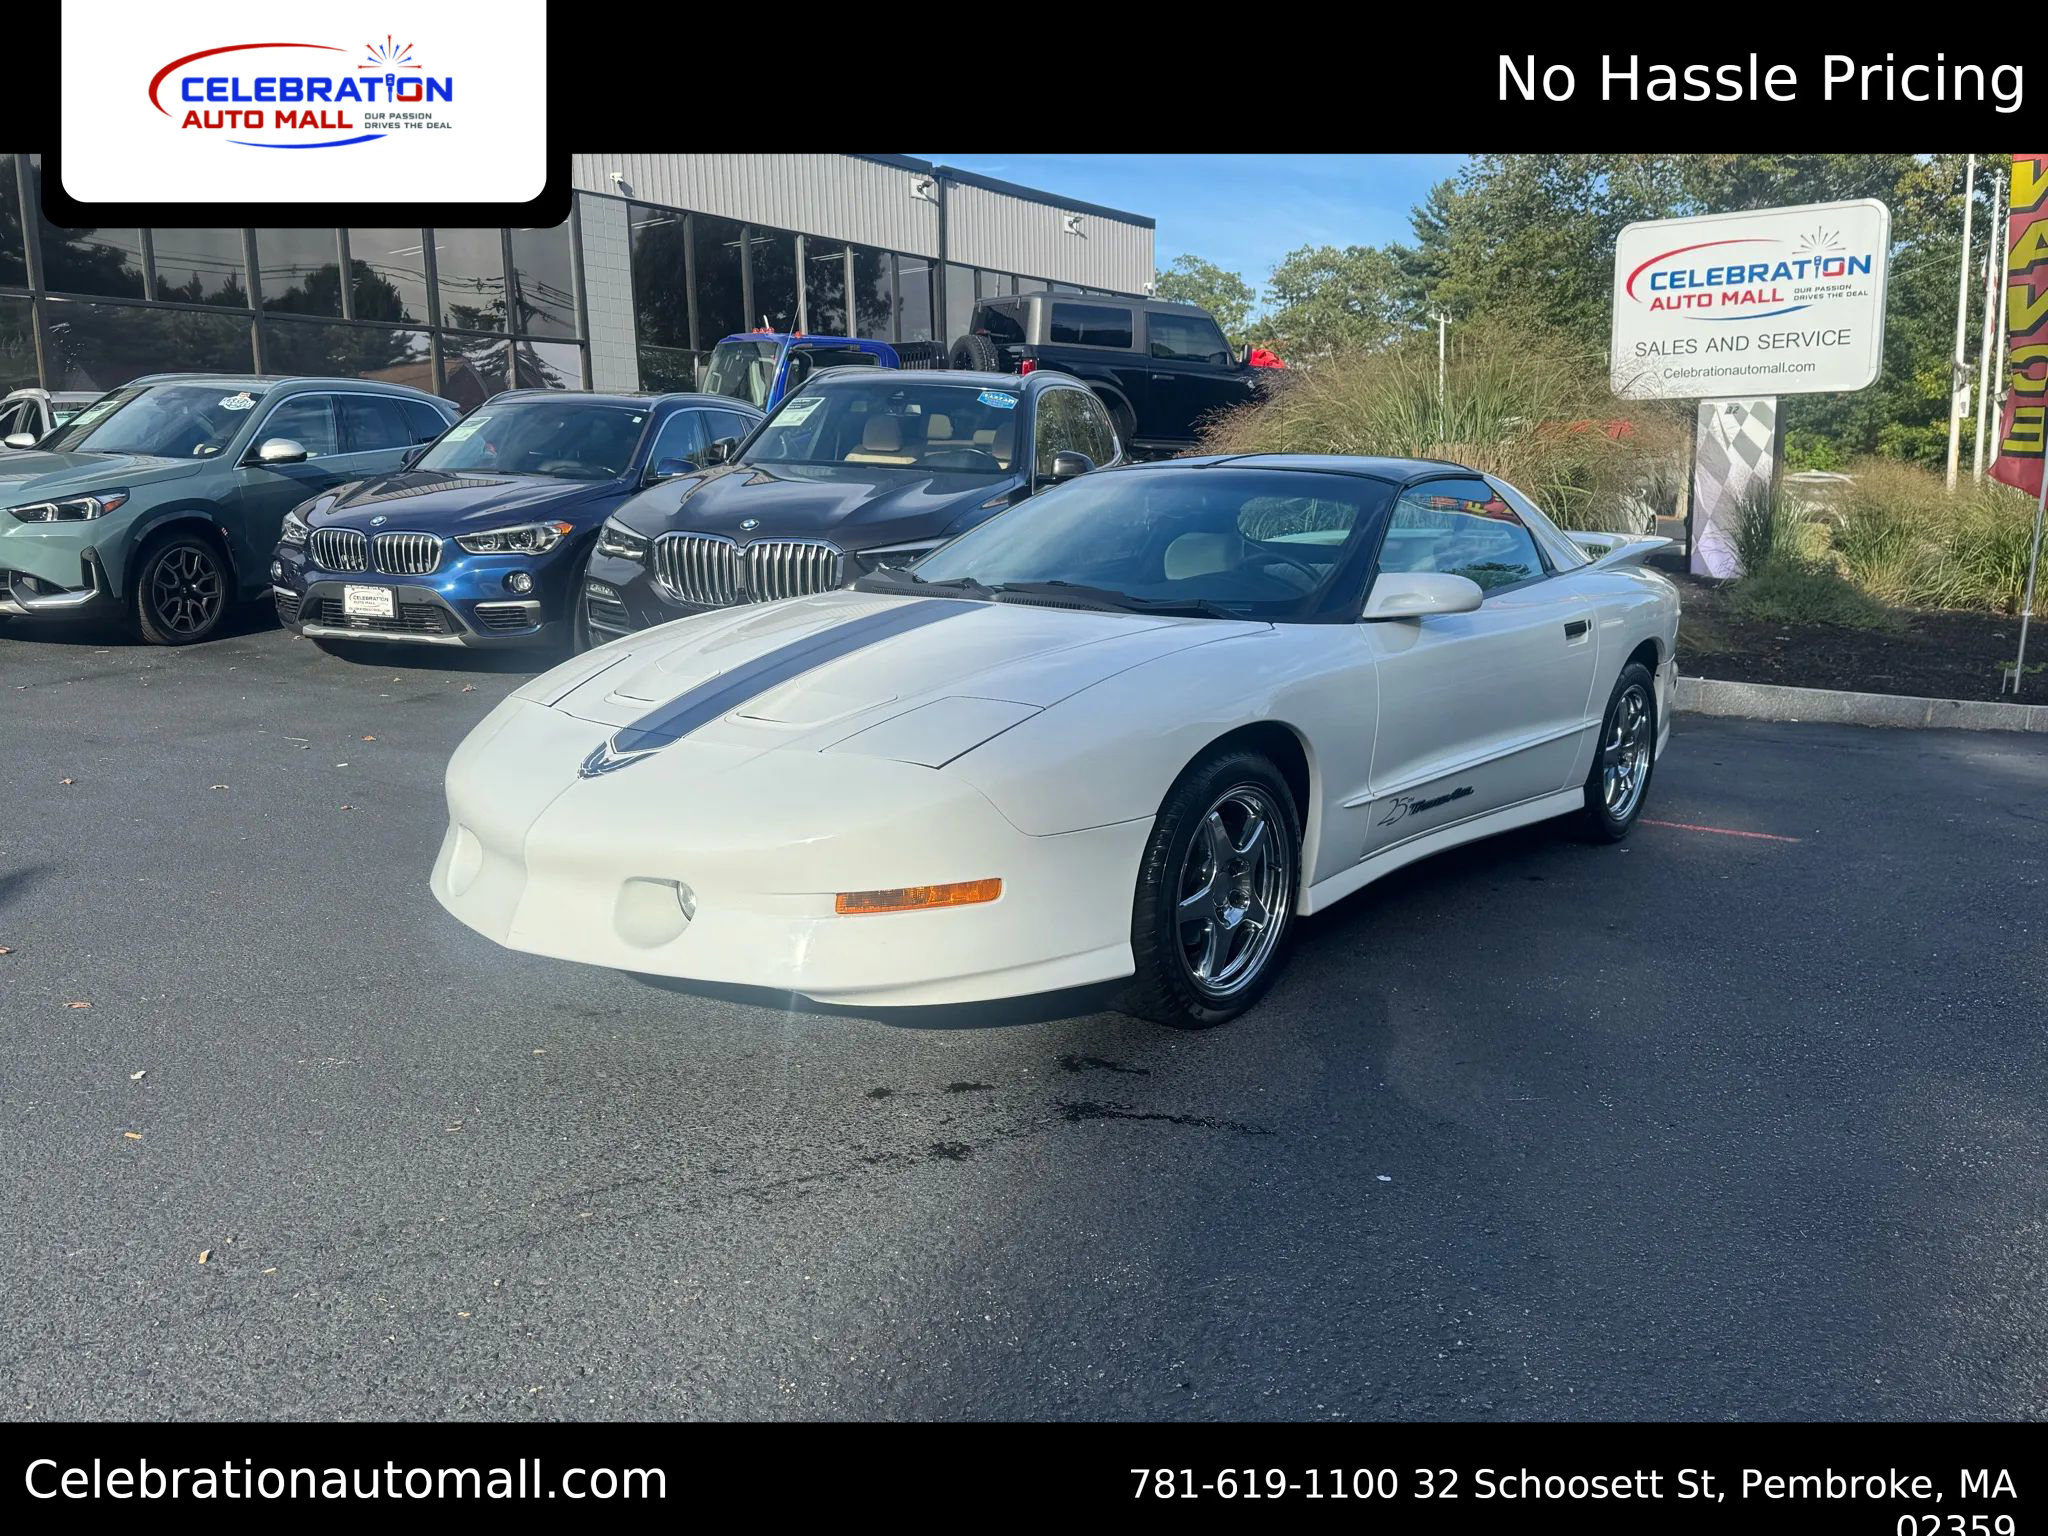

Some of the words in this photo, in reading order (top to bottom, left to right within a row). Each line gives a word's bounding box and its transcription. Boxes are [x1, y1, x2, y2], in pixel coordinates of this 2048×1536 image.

[1650, 254, 1872, 291] CELEBRATION
[1814, 284, 1852, 293] PASSION
[1827, 291, 1843, 299] THE
[1846, 289, 1869, 298] DEAL
[1649, 293, 1713, 312] AUTO
[1721, 288, 1785, 306] MALL
[1634, 338, 1698, 358] SALES
[1705, 335, 1750, 354] AND
[1757, 328, 1852, 350] SERVICE
[1663, 361, 1816, 379] Celebrationautomall.com
